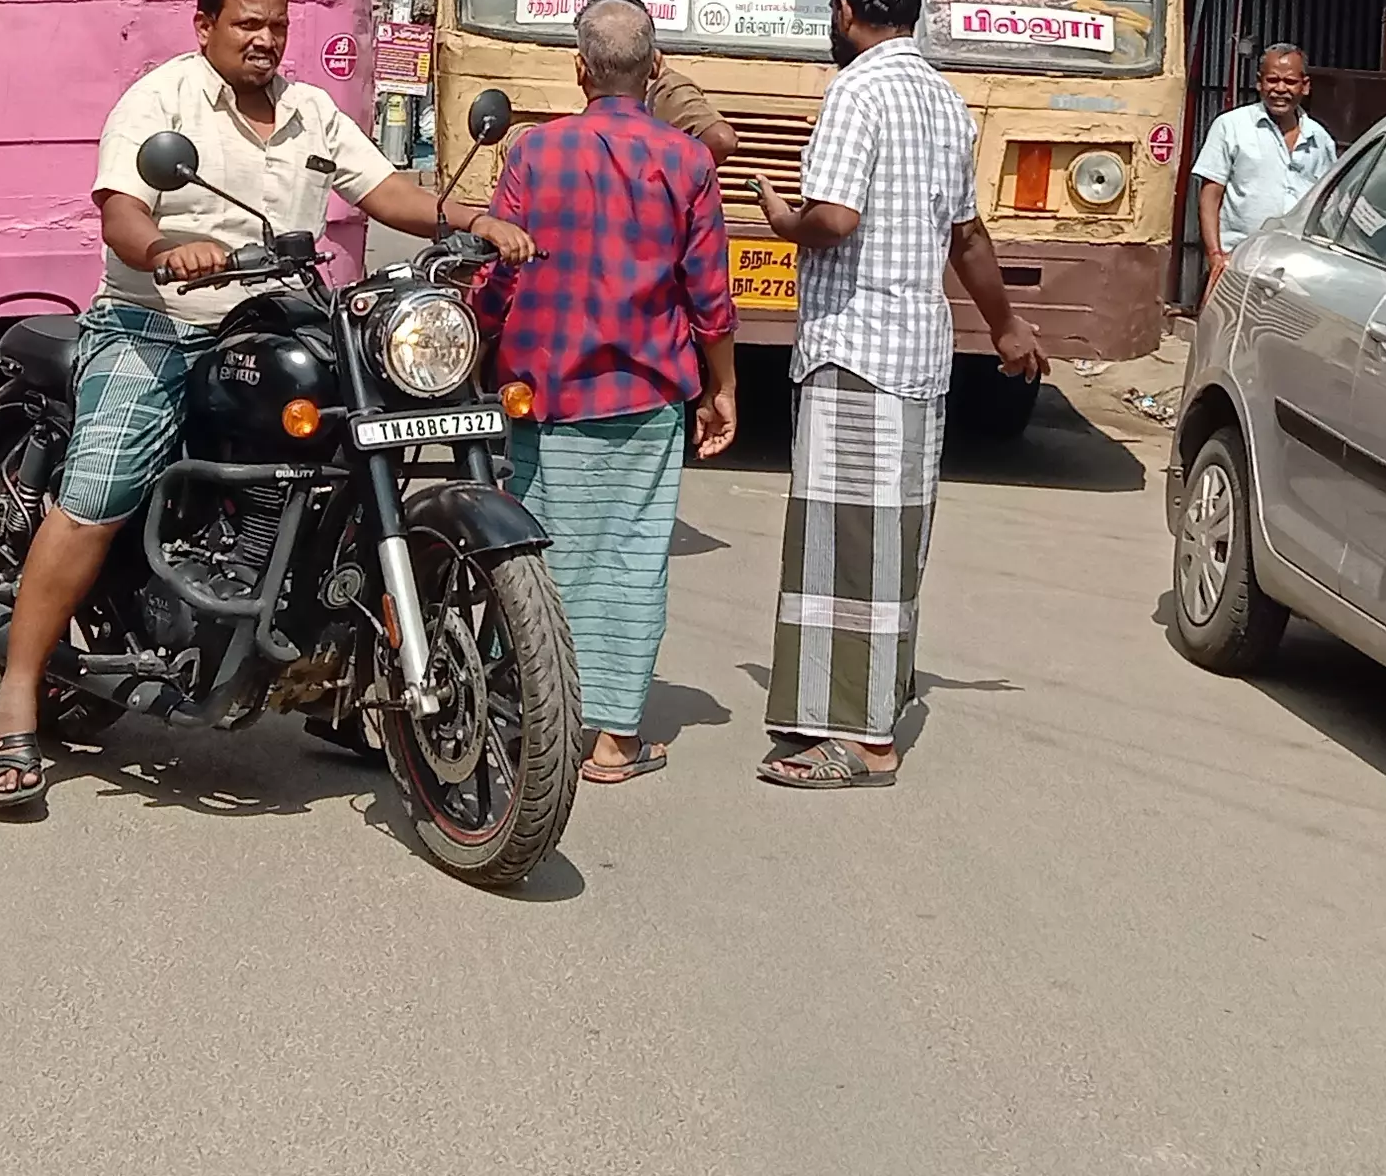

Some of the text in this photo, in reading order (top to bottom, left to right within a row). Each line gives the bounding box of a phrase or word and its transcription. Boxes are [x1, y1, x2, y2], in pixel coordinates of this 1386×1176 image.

[963, 8, 1105, 43] பில்லூர்
[739, 250, 797, 270] தநா-4
[379, 412, 495, 441] TN48BC7327
[275, 469, 315, 479] QUALITY
